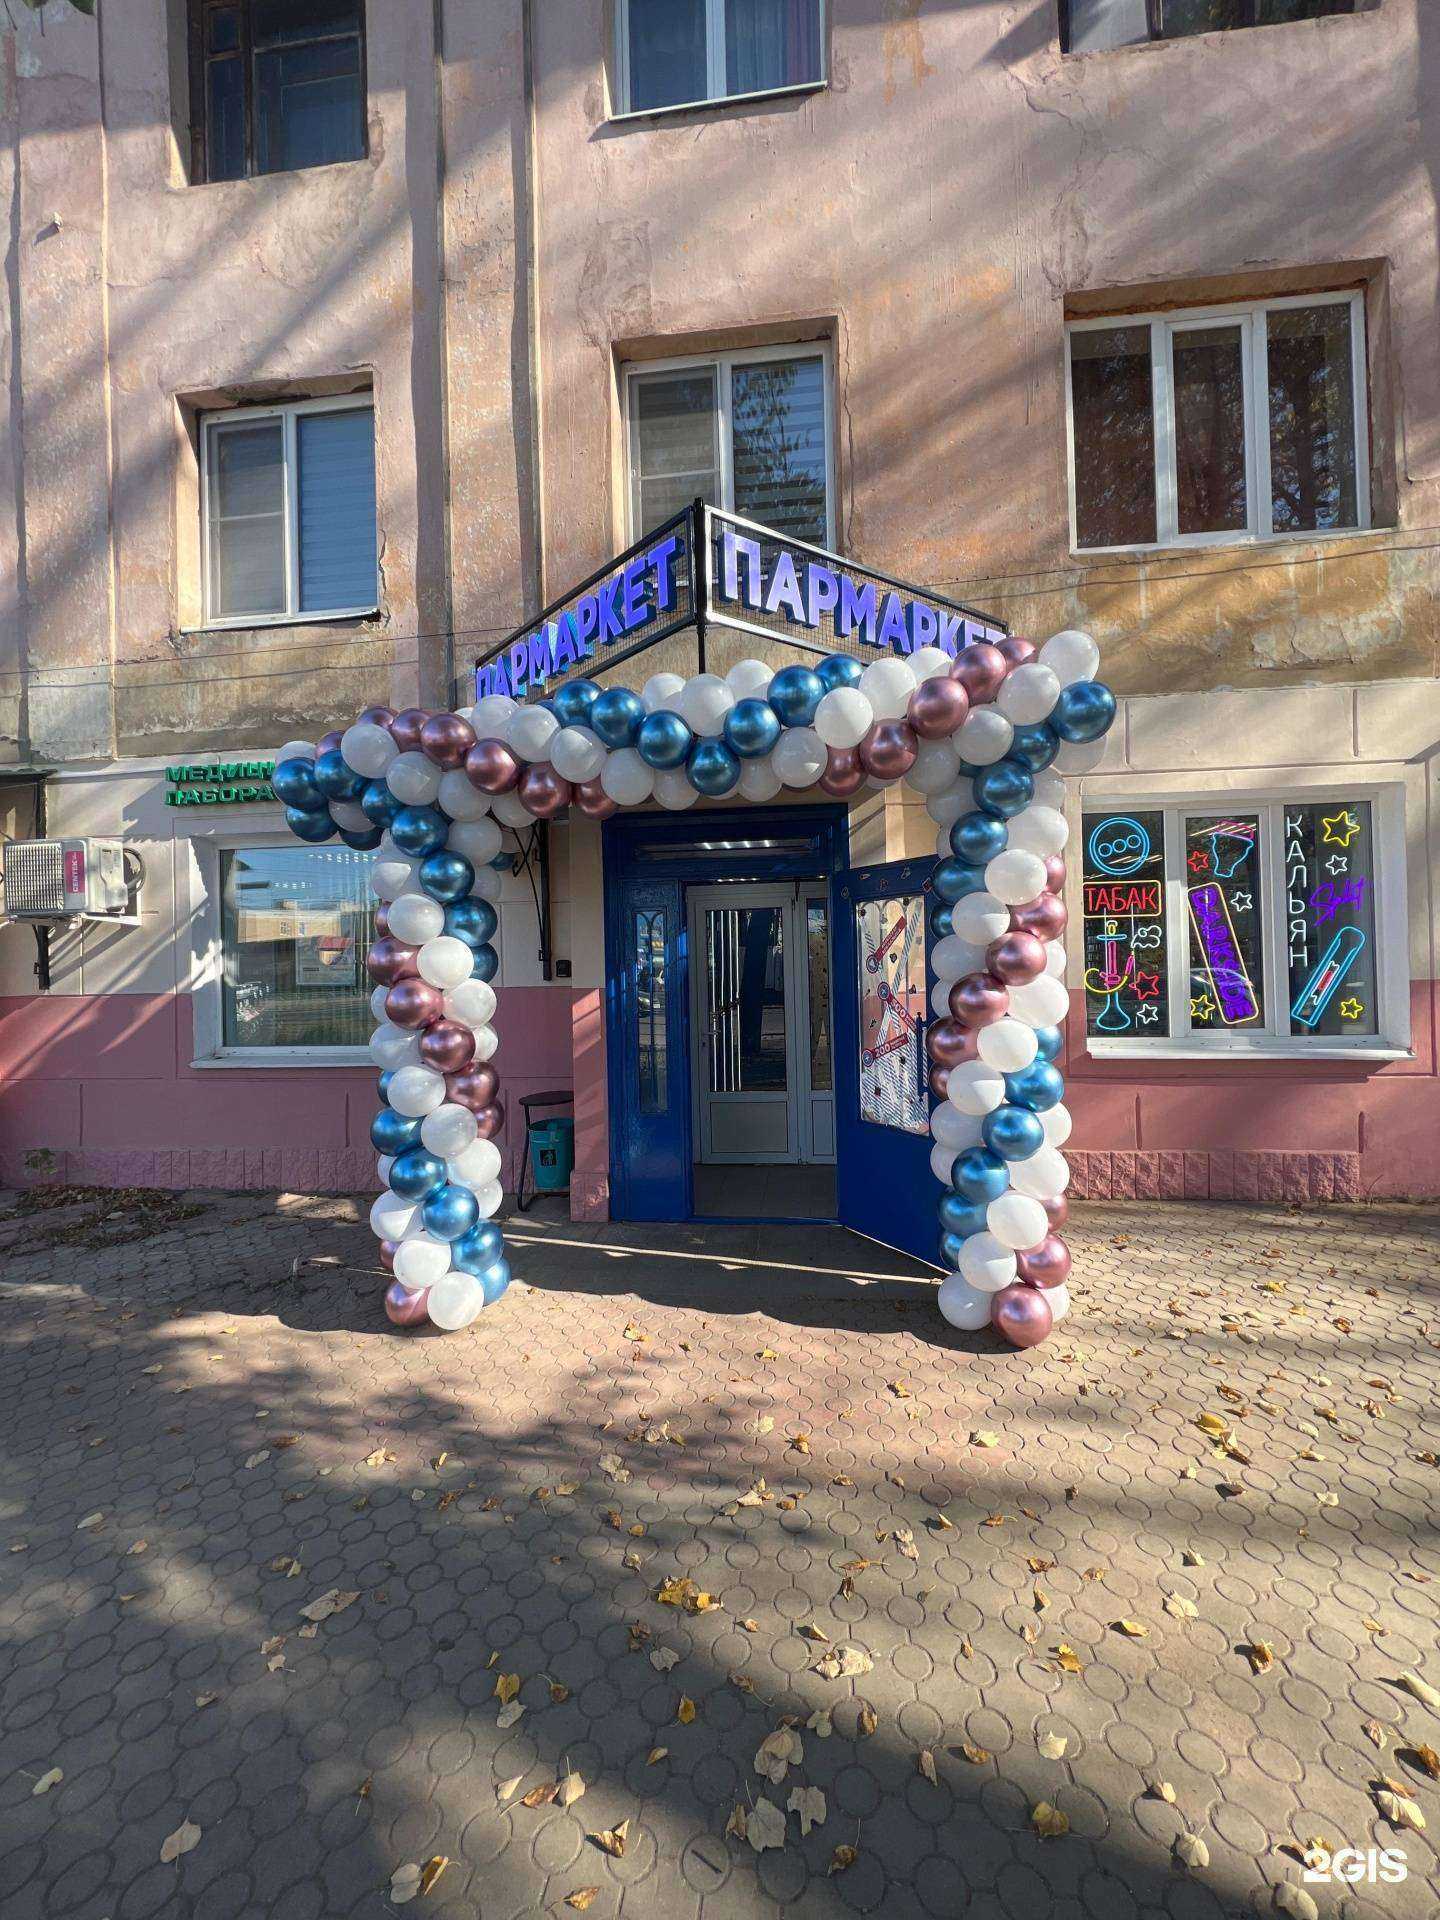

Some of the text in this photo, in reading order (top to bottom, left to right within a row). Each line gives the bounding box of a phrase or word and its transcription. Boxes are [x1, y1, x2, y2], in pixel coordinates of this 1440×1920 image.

[475, 536, 682, 700] ПАРМАРКЕТ
[720, 531, 1007, 660] ПАРМАРКЕ
[1084, 886, 1158, 912] ТАБАК
[1190, 887, 1253, 1019] DARKSIDE
[1286, 815, 1308, 967] КАЛЬЯН
